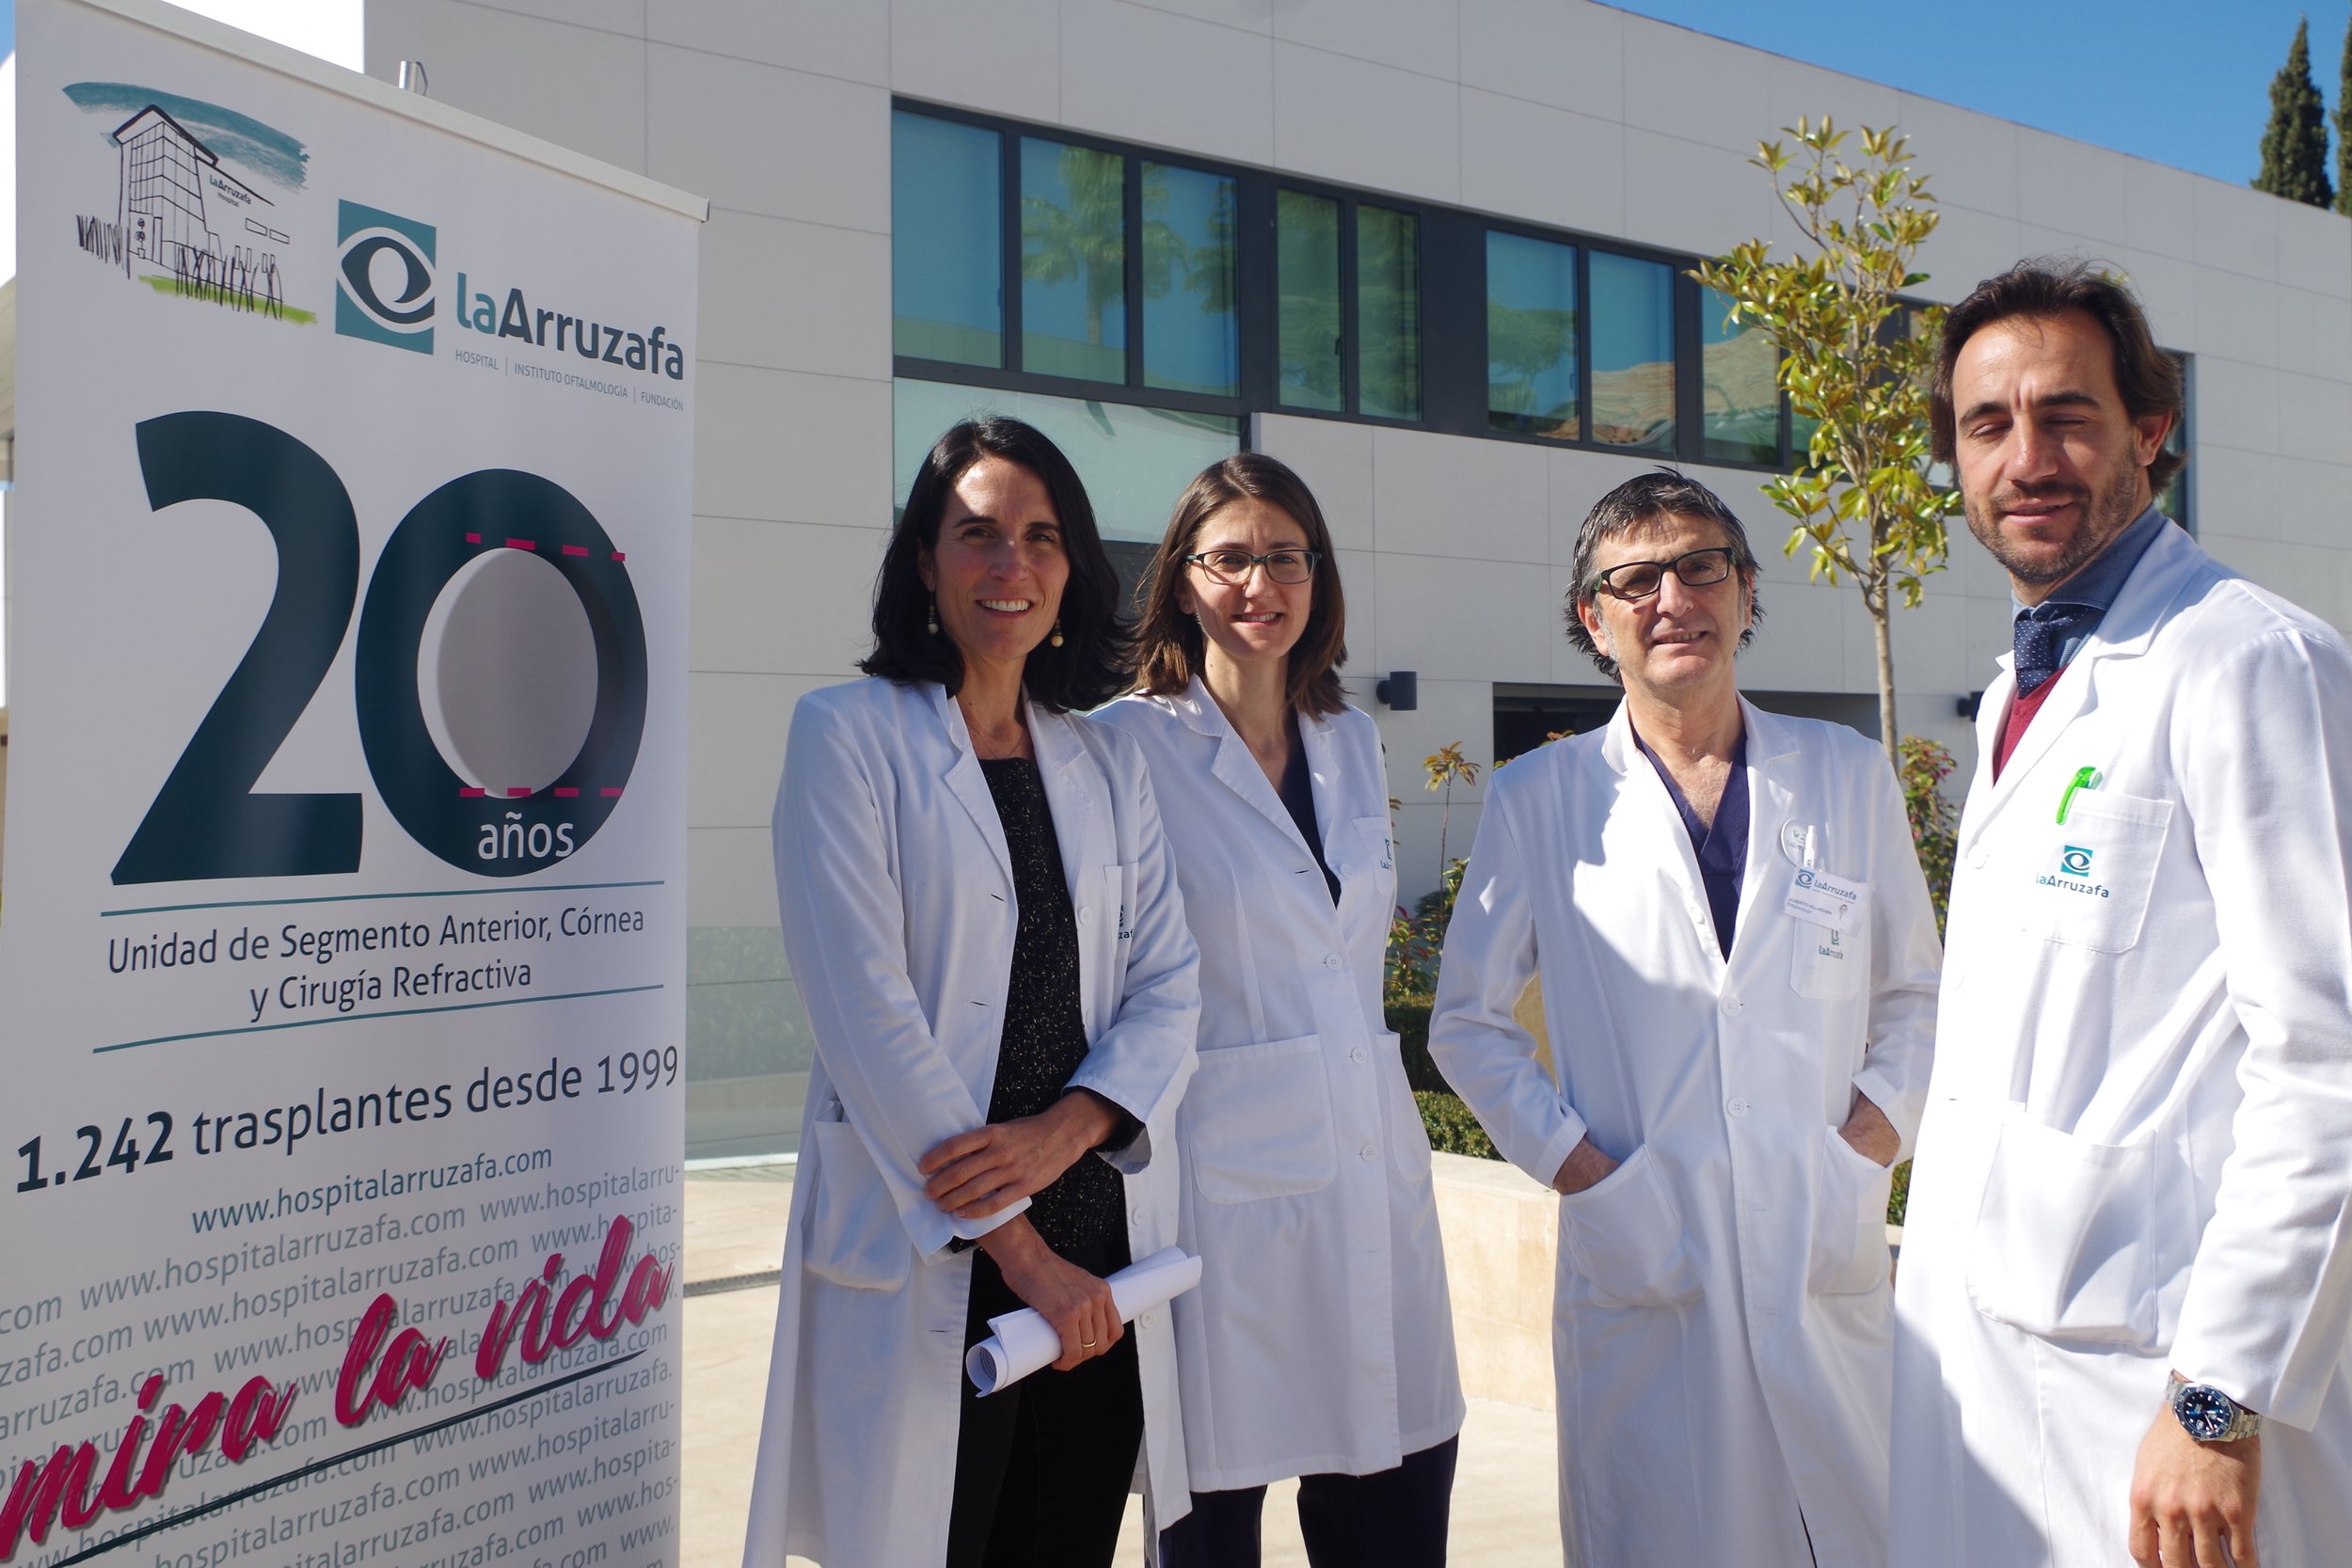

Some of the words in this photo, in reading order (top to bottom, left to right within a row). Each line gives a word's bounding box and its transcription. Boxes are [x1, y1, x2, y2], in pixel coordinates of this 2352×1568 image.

[456, 271, 684, 381] laArruzafa
[455, 349, 500, 371] HOSPITAL
[514, 362, 563, 384] INSTITUTO
[564, 372, 628, 399] OFTALMOLOGÍA
[641, 389, 684, 412] FUNDACIÓN
[110, 410, 648, 886] 20
[478, 811, 575, 860] años
[2036, 873, 2109, 897] laArruzafa
[108, 929, 218, 974] Unidad
[228, 927, 270, 962] de
[279, 917, 431, 964] Segmento
[438, 911, 552, 946] Anterior,
[560, 906, 644, 937] Córnea
[249, 987, 269, 1023] y
[278, 967, 383, 1013] Cirugía
[393, 959, 532, 999] Refractiva
[17, 1111, 174, 1193] 1.242
[192, 1082, 453, 1156] trasplantes
[466, 1057, 582, 1115] desde
[597, 1044, 679, 1094] 1999
[192, 1148, 553, 1233] www.hospitalarruzafa.com
[80, 1207, 465, 1311] www.hospitalarruzafa.com
[480, 1164, 680, 1223] www.hospitalarru-
[143, 1239, 517, 1342] www.hospitalarruzafa.com
[532, 1202, 677, 1253] www.hspita-
[335, 1293, 447, 1424] la
[469, 1400, 675, 1482] www.hospitalarru-
[528, 1437, 677, 1504] www.hospita-
[577, 1476, 678, 1528] www.hos-
[619, 1513, 675, 1552] www.
